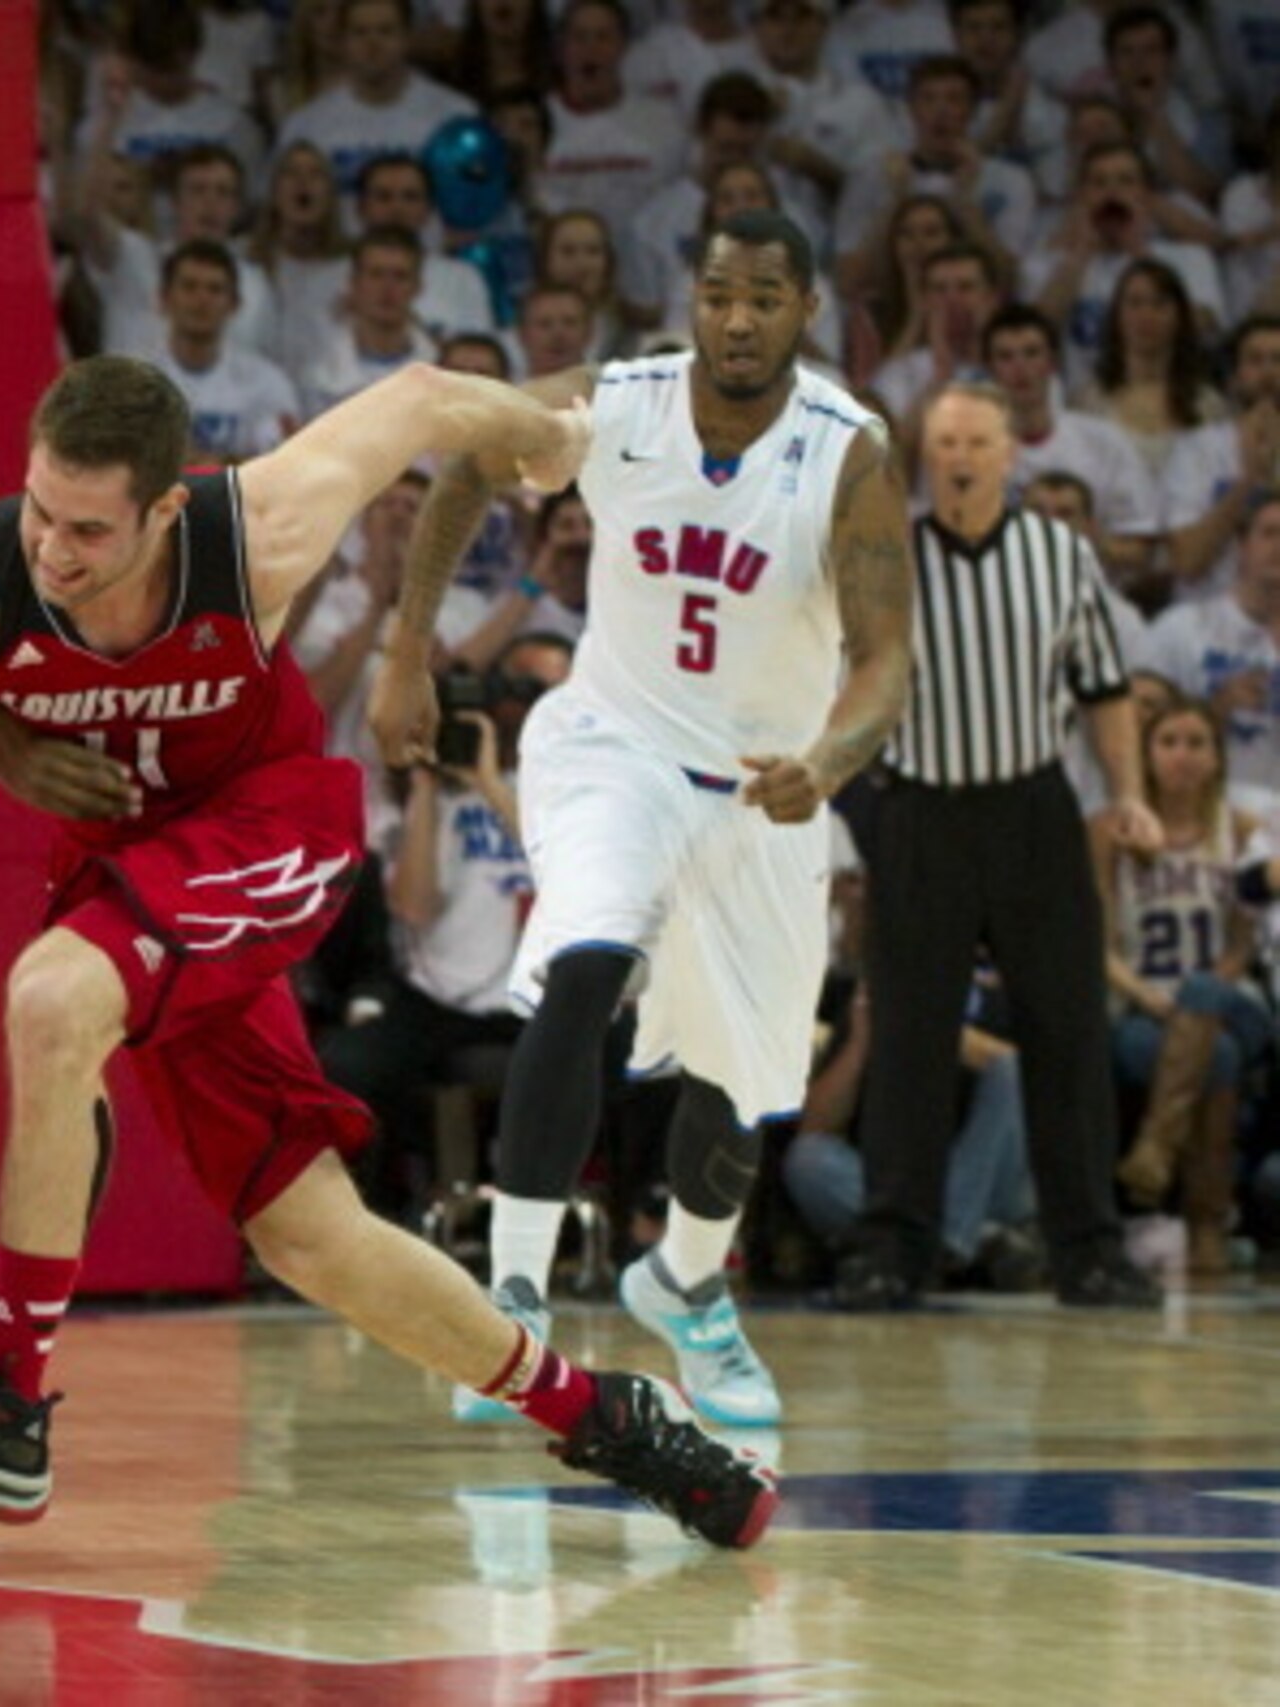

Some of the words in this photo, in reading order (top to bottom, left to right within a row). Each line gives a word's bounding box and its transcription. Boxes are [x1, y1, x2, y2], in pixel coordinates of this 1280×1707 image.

[633, 524, 769, 595] SMU
[676, 592, 717, 674] 5
[1137, 908, 1214, 978] 21
